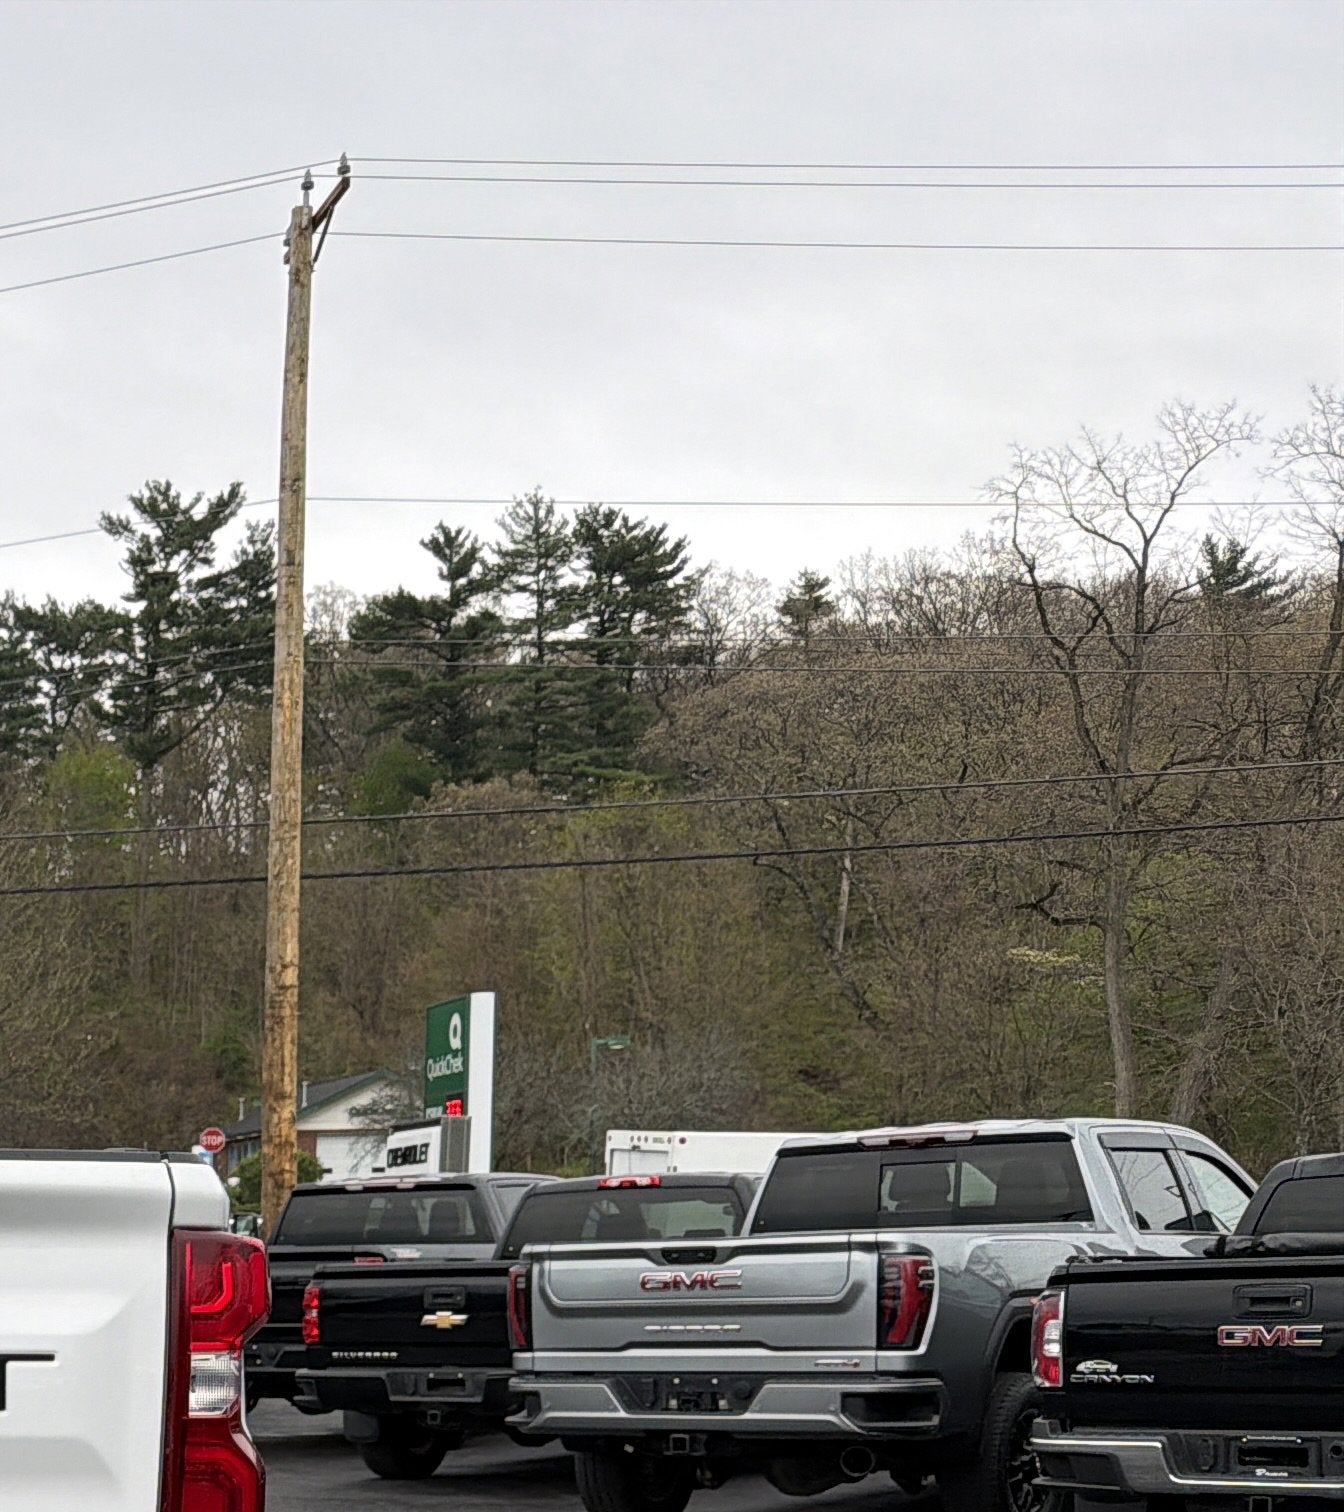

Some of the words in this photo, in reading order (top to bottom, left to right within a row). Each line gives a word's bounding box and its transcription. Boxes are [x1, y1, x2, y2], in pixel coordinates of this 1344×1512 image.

[427, 1052, 463, 1081] QuickChek
[201, 1134, 224, 1147] STOP
[640, 1269, 742, 1292] GMC
[1218, 1324, 1325, 1347] GMC
[331, 1351, 399, 1360] SILVERADO
[1069, 1374, 1155, 1384] CANYON
